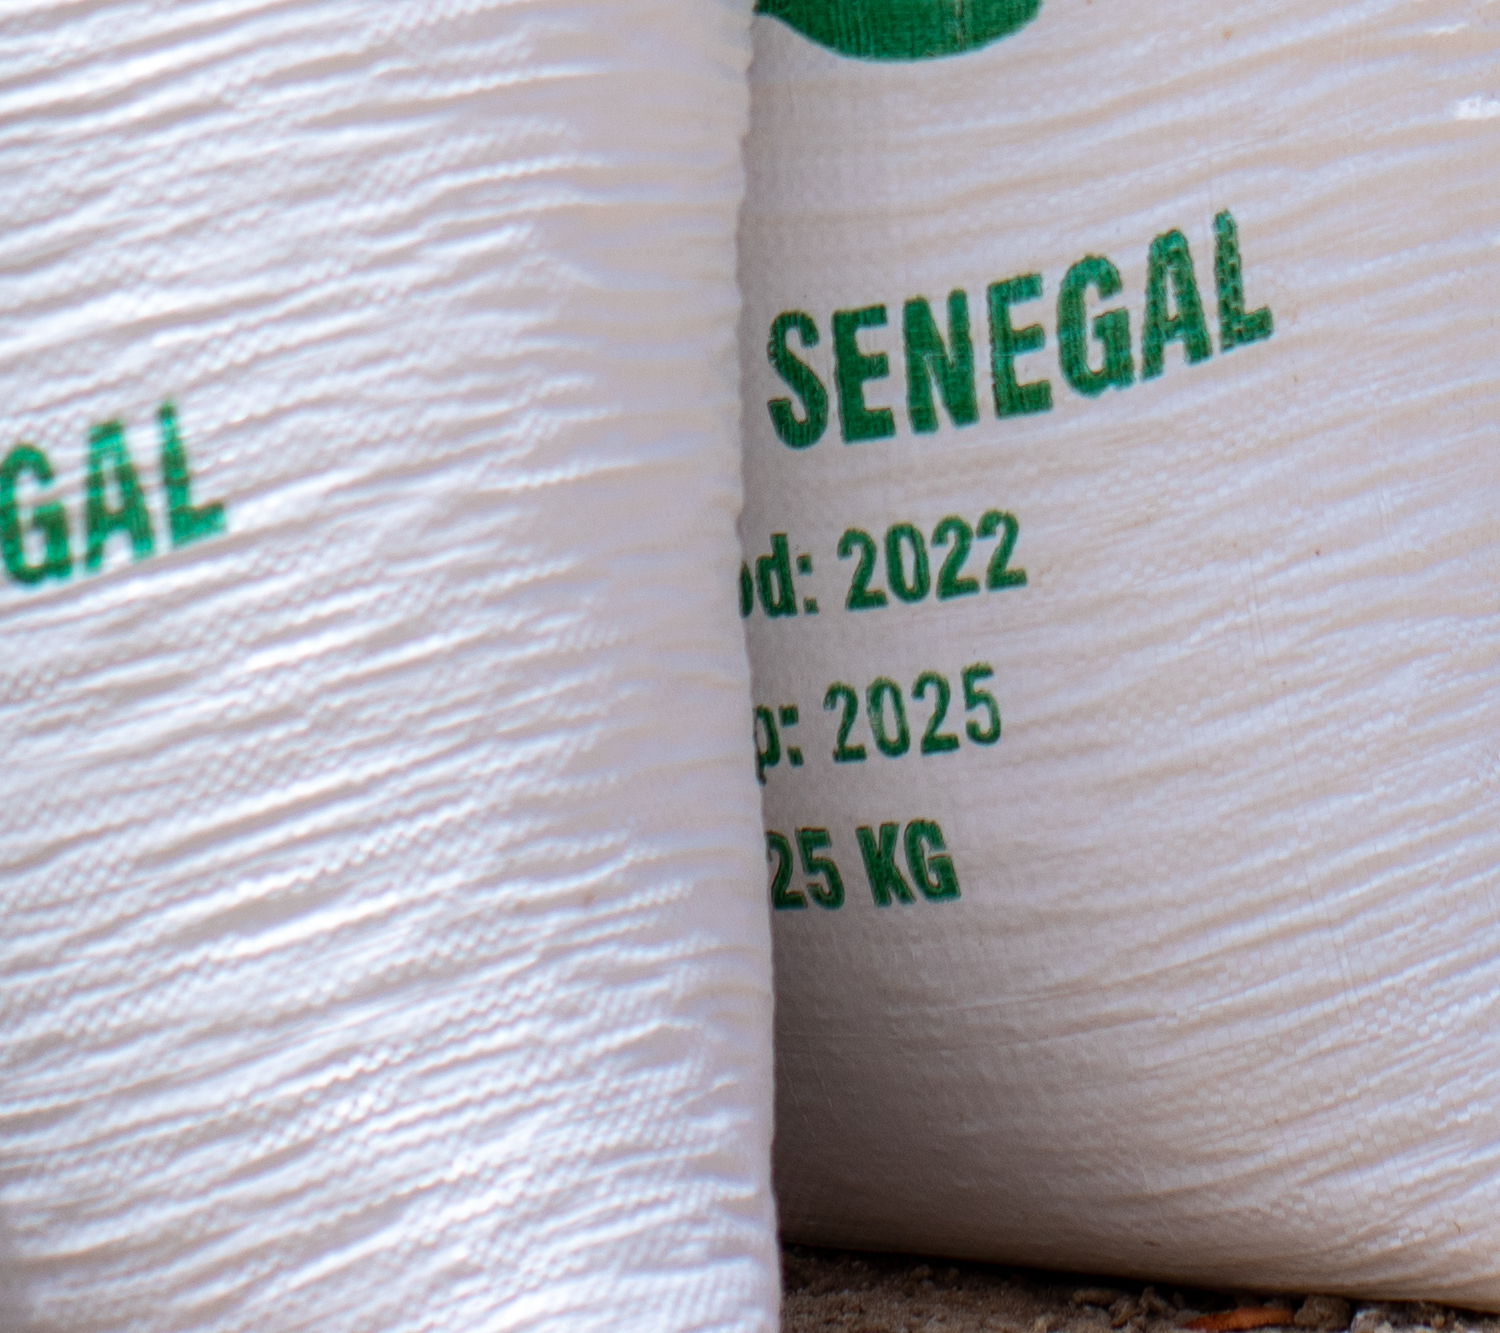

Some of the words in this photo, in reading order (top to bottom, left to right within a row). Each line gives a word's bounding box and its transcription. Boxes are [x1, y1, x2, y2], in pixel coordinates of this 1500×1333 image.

[767, 210, 1275, 450] SENEGAL
[837, 509, 1027, 613] 2022
[823, 663, 1001, 764] 2025
[766, 828, 844, 911] 25
[855, 819, 960, 908] KG
